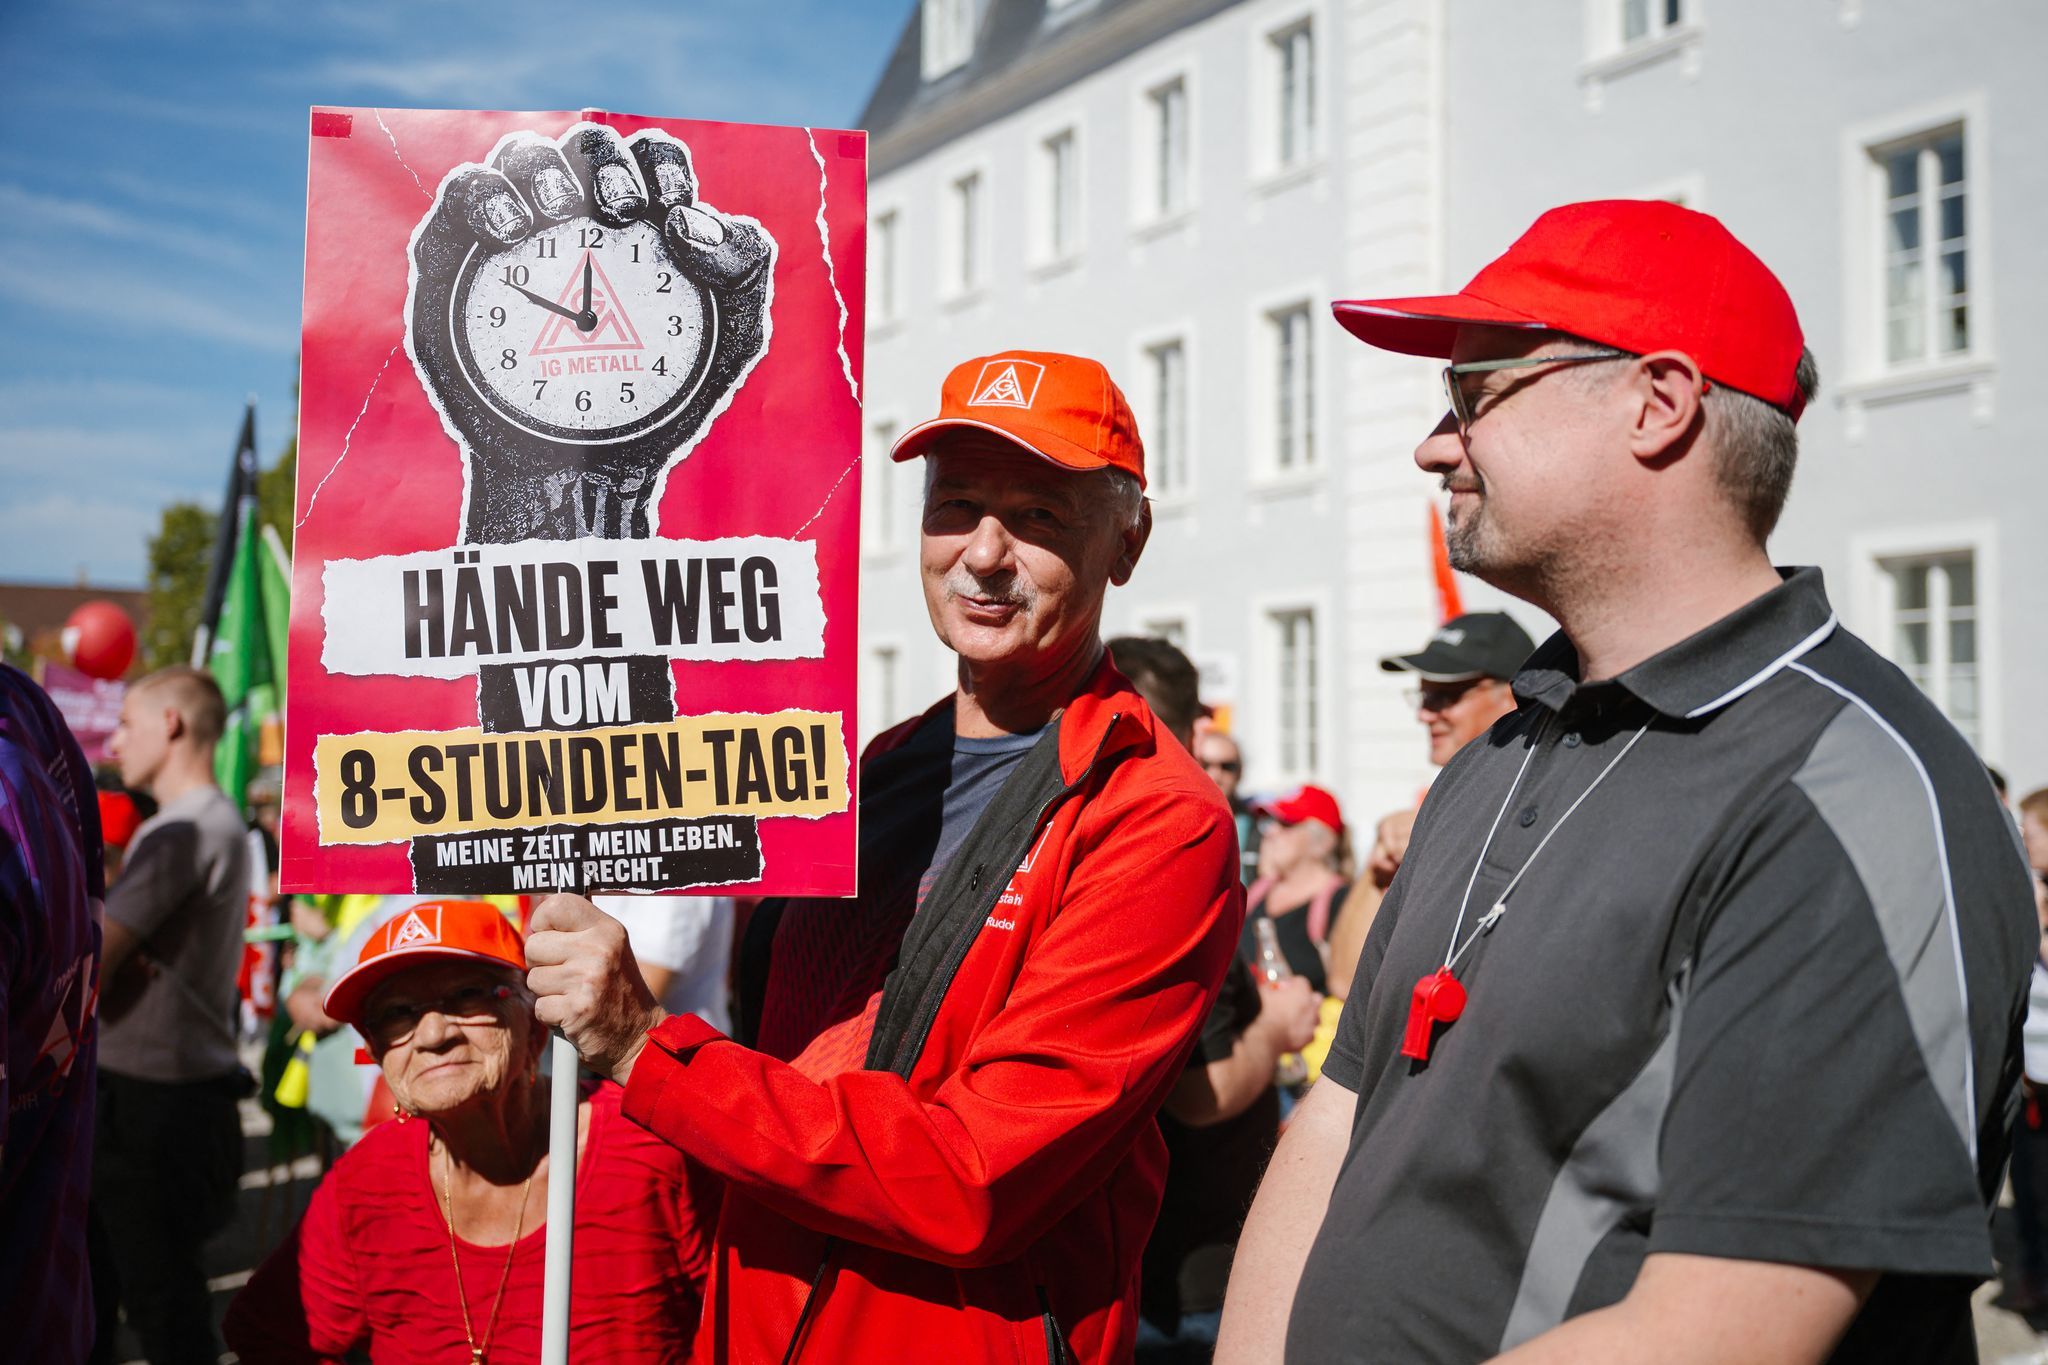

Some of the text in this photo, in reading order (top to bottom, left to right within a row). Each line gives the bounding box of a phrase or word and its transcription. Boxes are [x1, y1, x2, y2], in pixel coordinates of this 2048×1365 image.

[535, 238, 558, 259] 11
[577, 227, 604, 249] 12
[630, 243, 641, 264] 1
[502, 264, 530, 288] 10
[656, 272, 673, 294] 2
[489, 306, 507, 329] 9
[667, 315, 683, 337] 3
[501, 348, 518, 370] 8
[540, 355, 645, 377] IG METALL
[651, 355, 669, 377] 4
[532, 380, 548, 401] 7
[575, 390, 592, 412] 6
[620, 382, 636, 404] 5
[402, 551, 783, 660] HÄNDE WEG
[514, 662, 632, 729] VOM
[339, 724, 830, 830] 8-STUNDEN-TAG!
[436, 823, 743, 867] MEINE ZEIT. MEIN LEBEN.
[512, 856, 670, 890] MEIN RECHT.
